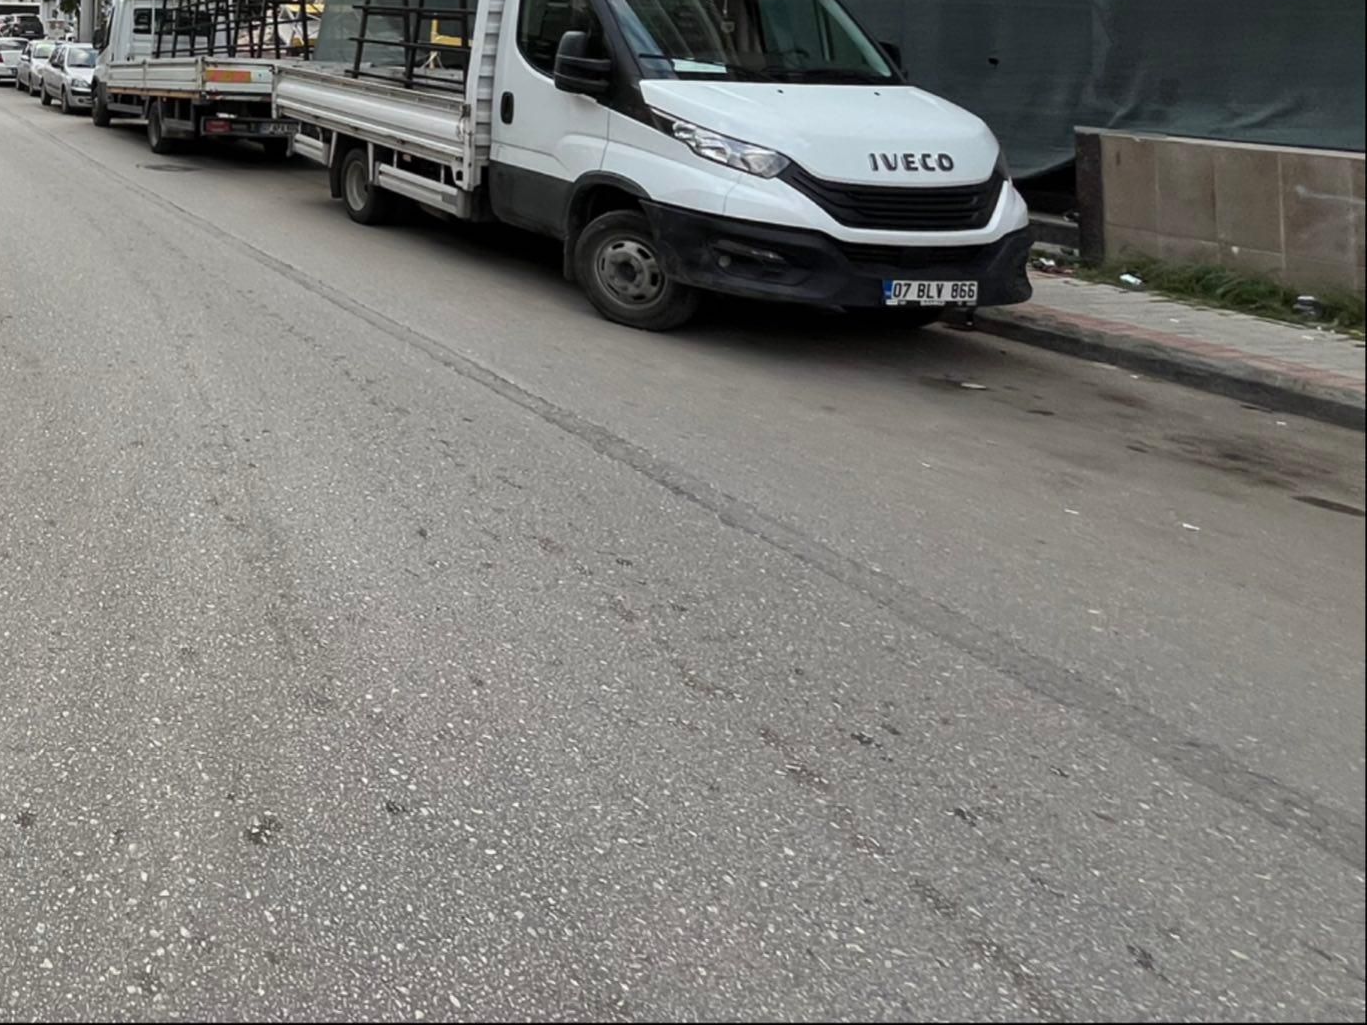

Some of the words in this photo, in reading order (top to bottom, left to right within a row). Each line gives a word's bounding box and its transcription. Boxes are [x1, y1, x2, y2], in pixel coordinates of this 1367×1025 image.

[868, 153, 954, 172] IVECO
[894, 283, 912, 298] 07
[951, 283, 975, 298] 866
